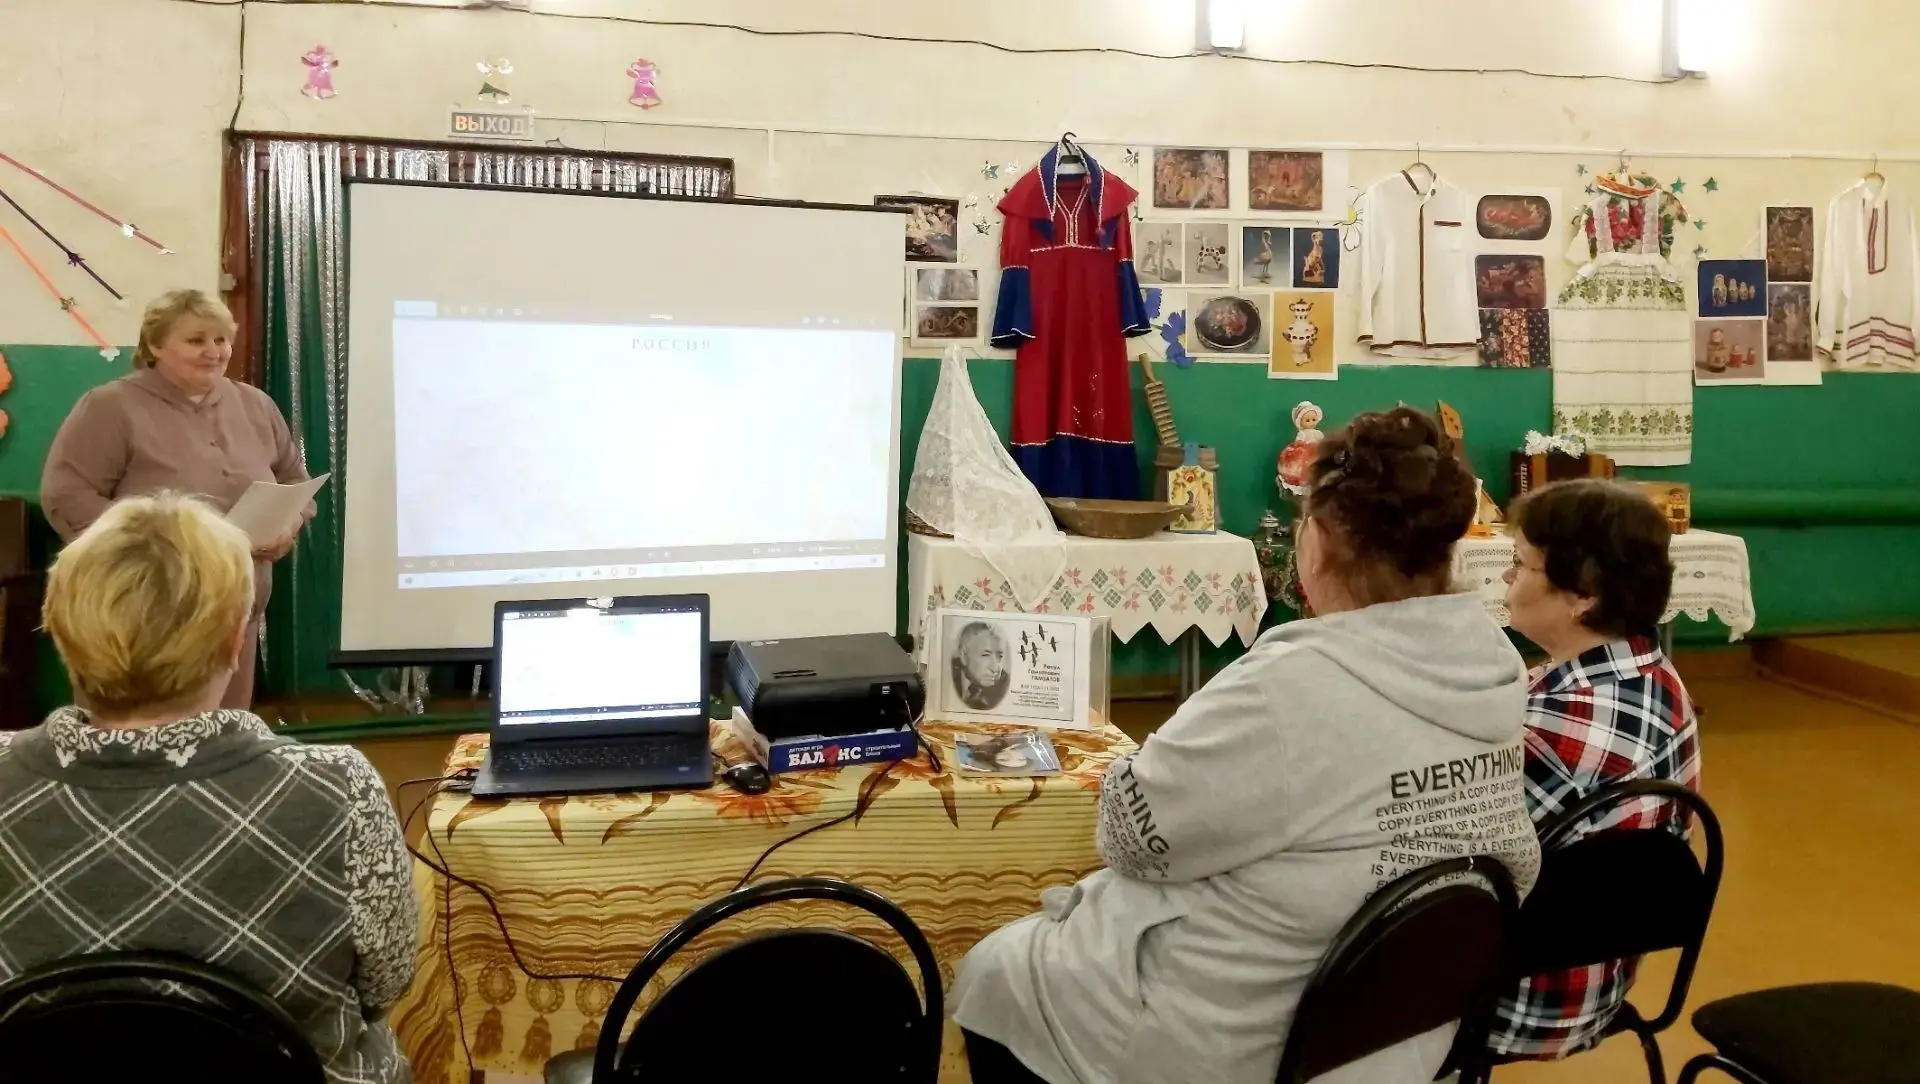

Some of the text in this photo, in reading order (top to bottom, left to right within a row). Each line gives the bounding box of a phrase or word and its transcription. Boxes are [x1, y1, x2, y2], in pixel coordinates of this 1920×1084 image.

[455, 115, 524, 134] ВЫХОД
[631, 338, 713, 351] РОССИЯ
[1390, 745, 1521, 799] EVERYTHING
[1376, 794, 1446, 817] EVERYTHING
[1448, 792, 1457, 803] IS
[1459, 790, 1467, 800] A
[1468, 784, 1489, 799] COPY
[1490, 782, 1499, 795] OF
[1114, 793, 1124, 809] OF
[1126, 822, 1145, 852] COPY
[1378, 816, 1412, 832] COPY
[1415, 803, 1477, 826] EVERYTHING
[1479, 801, 1486, 812] IS
[1488, 800, 1493, 810] A
[1494, 796, 1511, 809] COPY
[1414, 830, 1421, 839] A
[1424, 824, 1454, 837] COPY
[1456, 821, 1468, 831] OF
[1471, 819, 1478, 829] A
[1479, 815, 1497, 828] COPY
[1391, 839, 1463, 855] EVERYTHING
[1469, 842, 1477, 853] IS
[1481, 842, 1488, 853] A
[1371, 863, 1384, 877] IS
[1388, 866, 1398, 878] A
